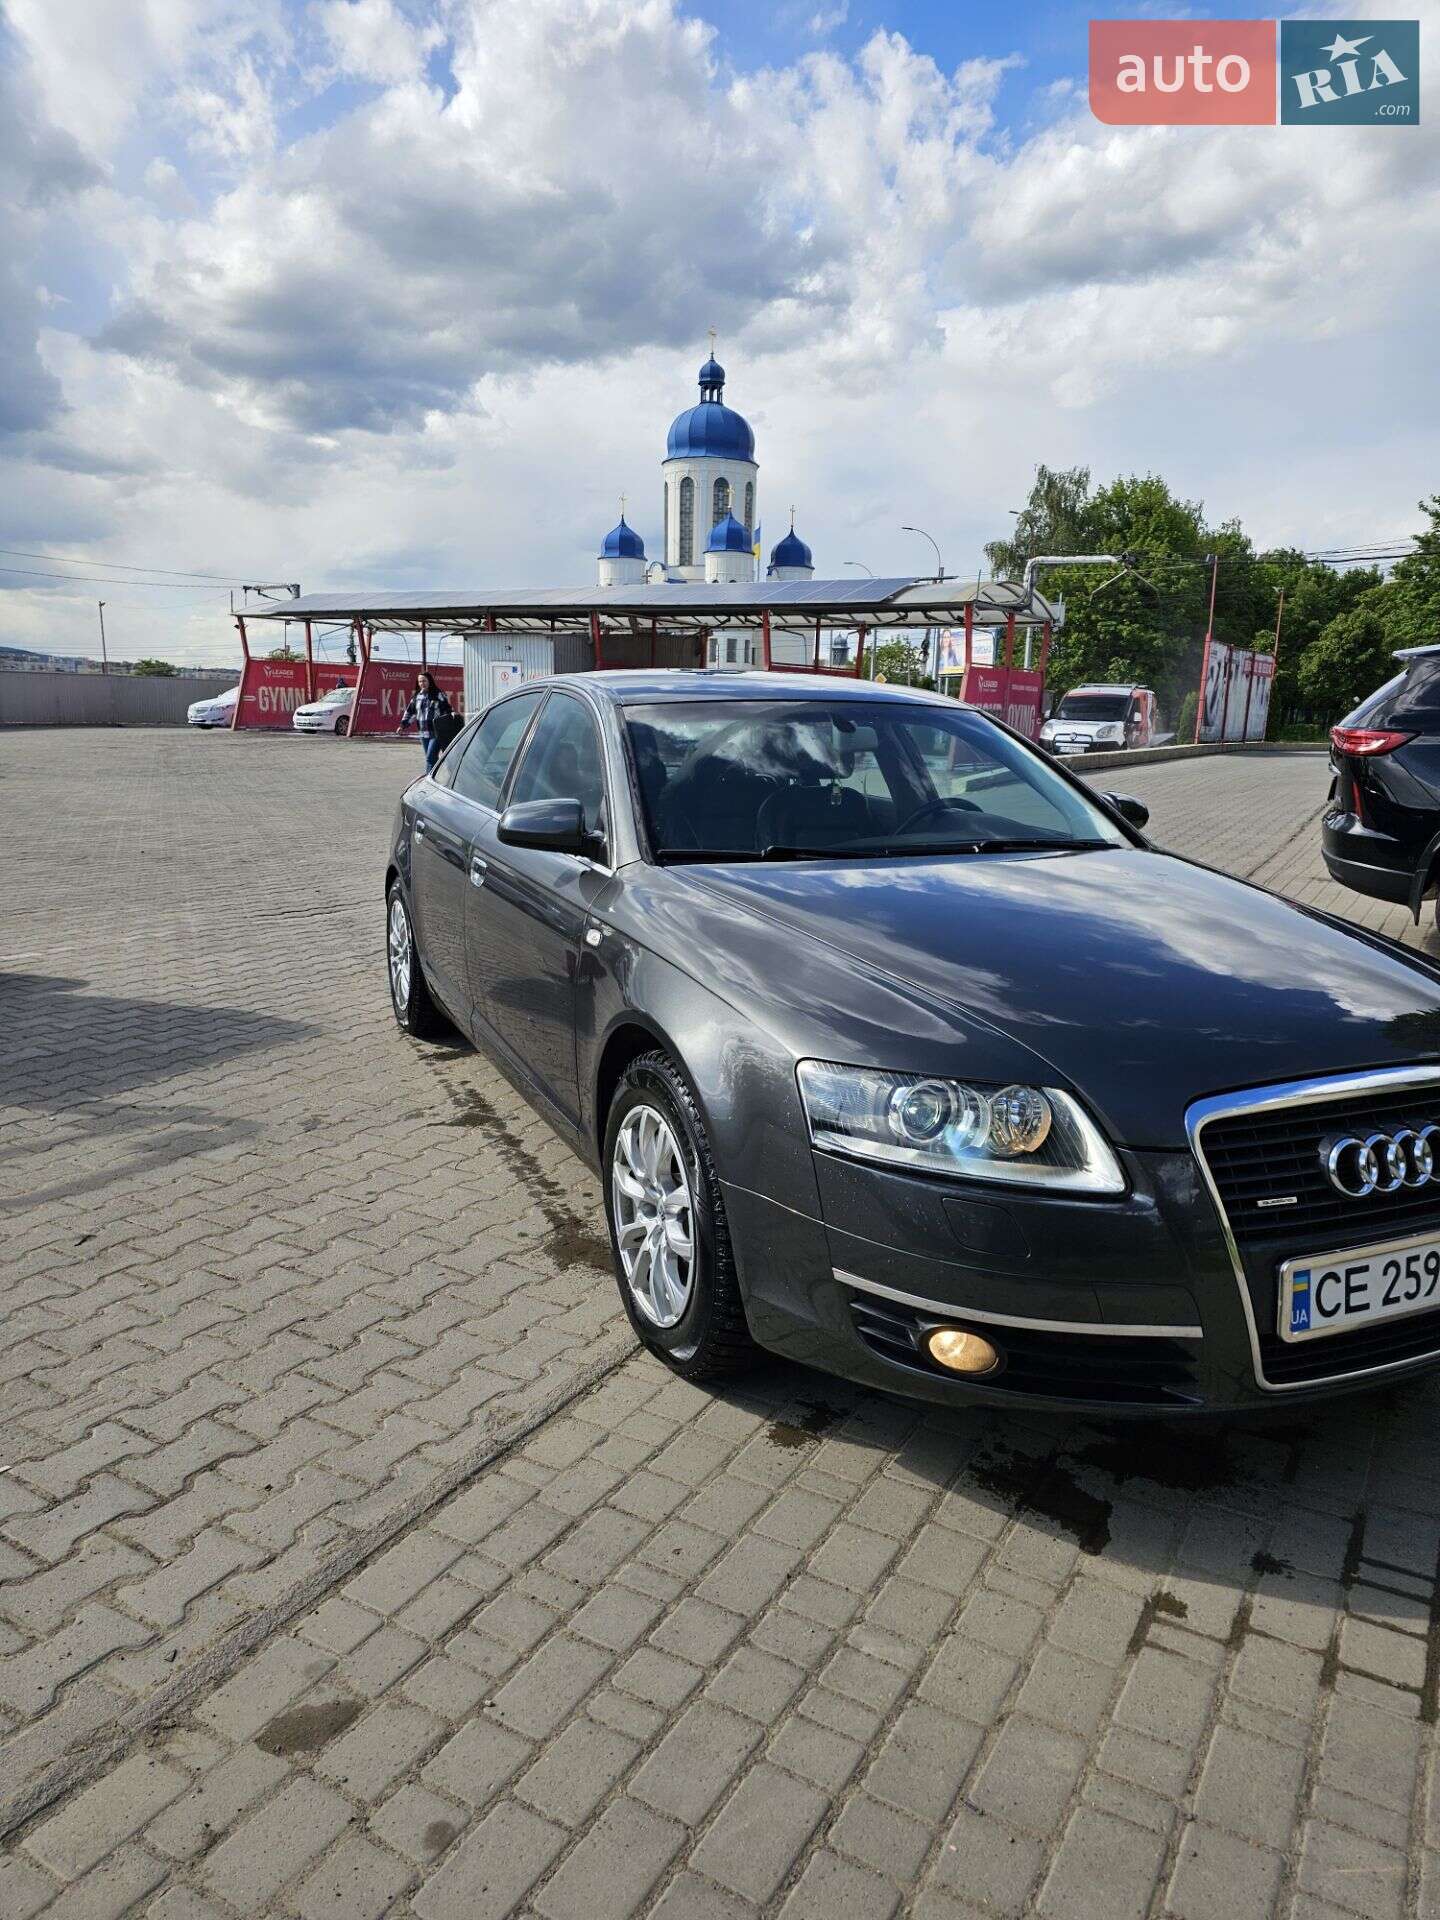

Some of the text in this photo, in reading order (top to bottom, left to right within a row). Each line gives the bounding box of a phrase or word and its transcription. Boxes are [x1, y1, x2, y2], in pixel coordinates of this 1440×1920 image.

[1315, 1250, 1440, 1318] CE 259
[1291, 1309, 1308, 1325] UA
